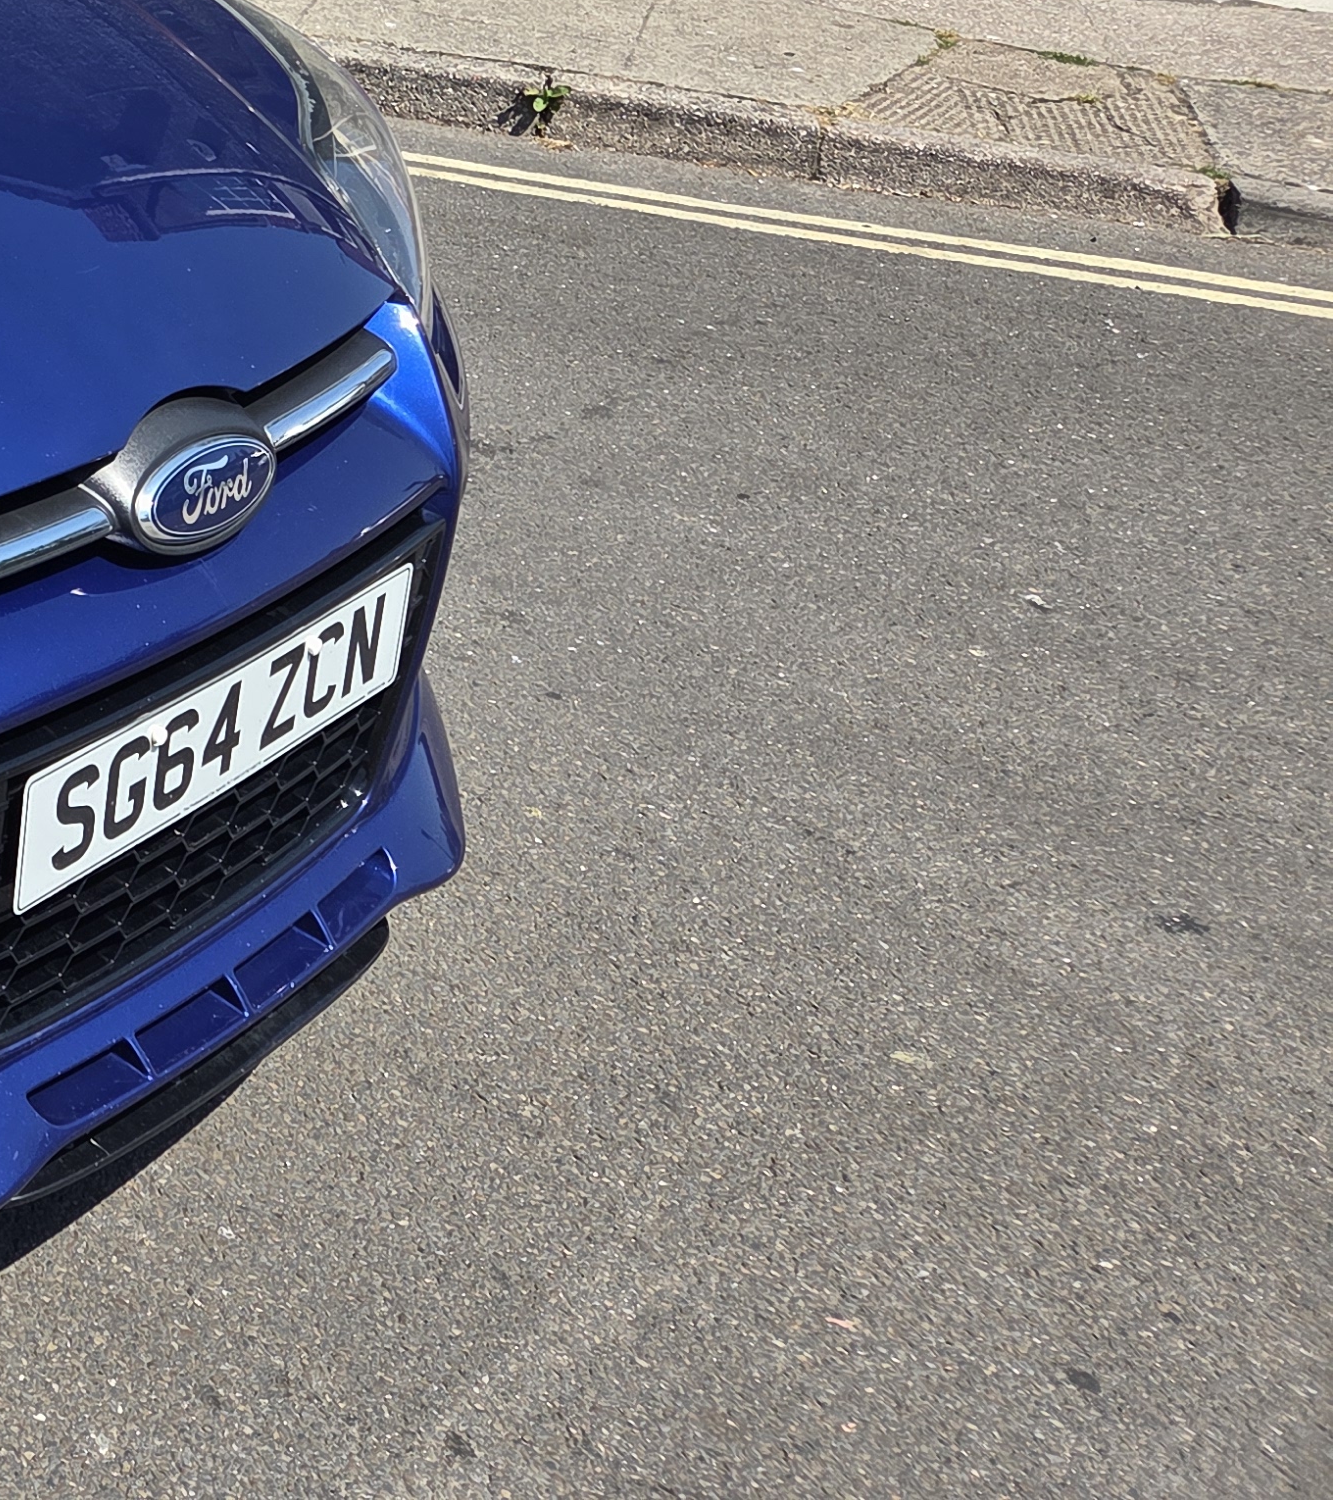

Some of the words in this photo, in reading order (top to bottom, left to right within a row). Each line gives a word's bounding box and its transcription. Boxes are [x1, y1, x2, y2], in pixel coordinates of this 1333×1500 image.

[182, 454, 253, 525] Ford
[51, 680, 244, 872] SG64
[259, 591, 387, 751] ZCN
